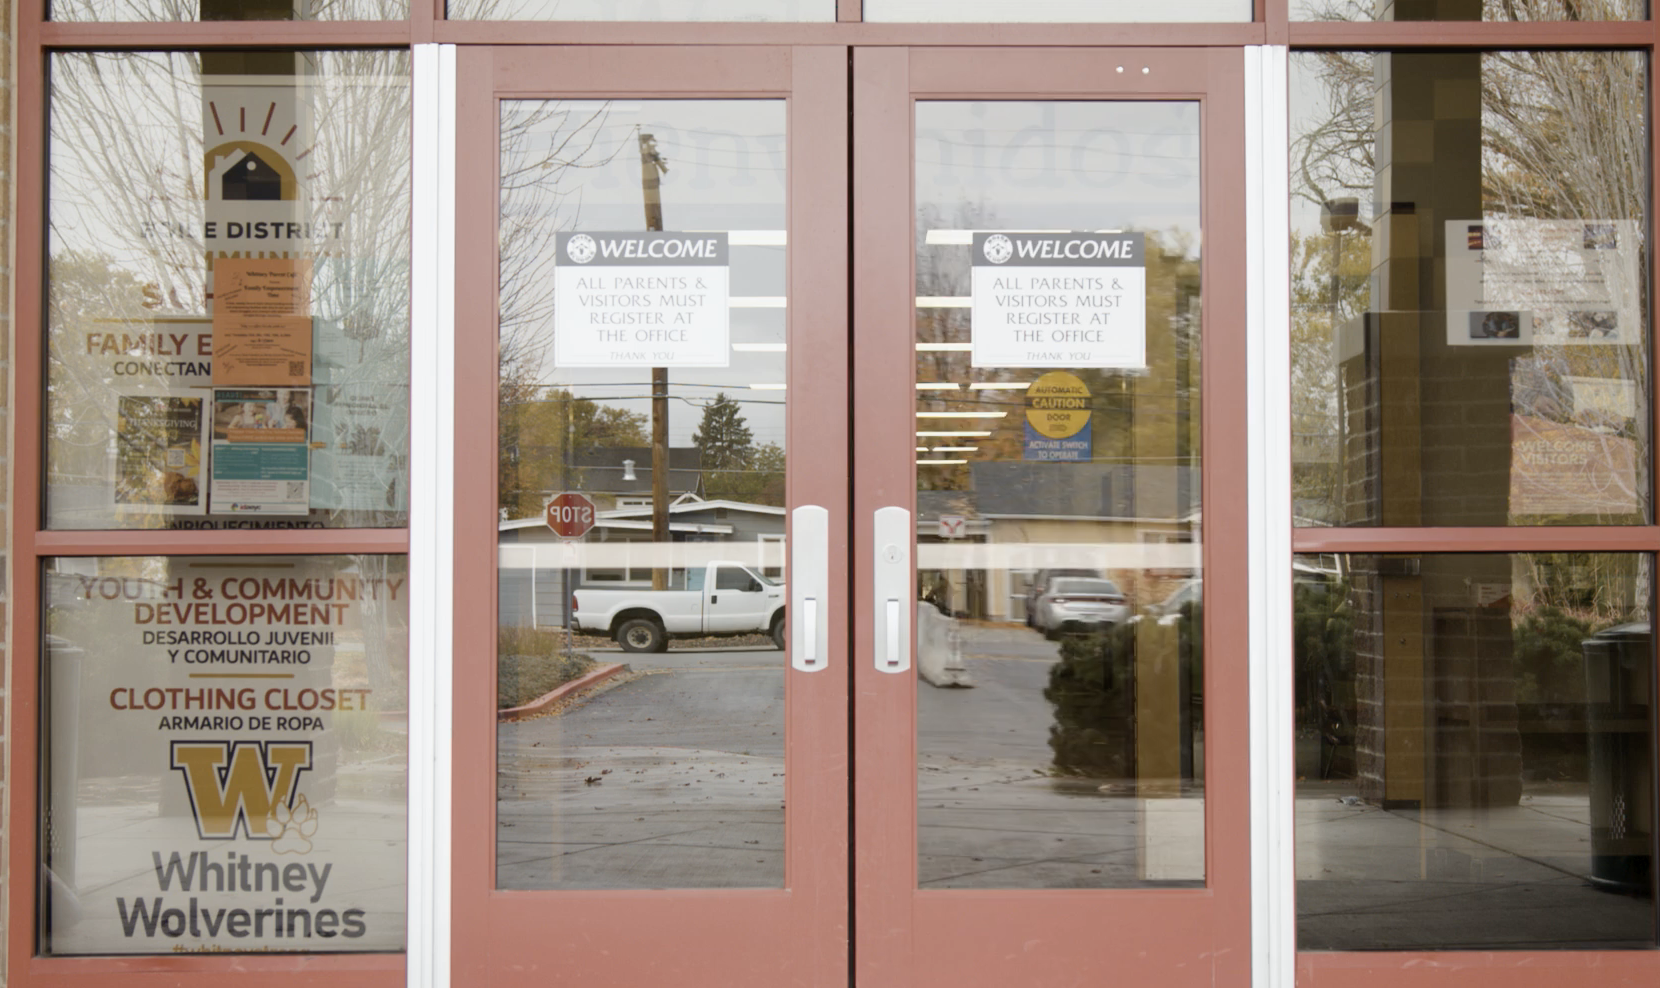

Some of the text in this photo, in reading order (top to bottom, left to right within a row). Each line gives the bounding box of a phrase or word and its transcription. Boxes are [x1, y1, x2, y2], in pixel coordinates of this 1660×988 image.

[600, 239, 717, 258] WELCOME
[1016, 240, 1133, 259] WELCOME
[576, 277, 708, 290] ALL PARENTS &
[993, 277, 1124, 290] ALL PARENTS &
[579, 294, 707, 307] VISITORS MUST
[995, 295, 1122, 308] VISITORS MUST
[590, 312, 694, 325] REGISTER AT
[1006, 312, 1111, 325] REGISTER AT
[597, 329, 688, 342] THE OFFICE
[1013, 330, 1105, 343] THE OFFICE
[86, 333, 189, 356] FAMILY
[610, 351, 675, 361] THANK YOU
[1026, 352, 1092, 361] THANK YOU
[1035, 386, 1083, 394] AUTOMATIC
[1032, 398, 1085, 409] CAUTION
[1046, 413, 1071, 421] DOOR
[1029, 441, 1088, 449] ACTIVATE SWITCH
[1519, 440, 1596, 452] WELCOME
[1037, 451, 1078, 459] TO OPERATE
[1521, 453, 1587, 465] VISITORS
[192, 577, 213, 600] &
[134, 603, 350, 625] DEVELOPMENT
[142, 630, 260, 645] DESARROLLO
[167, 649, 311, 664] Y COMUNITARIO
[109, 687, 373, 711] CLOTHING CLOSET
[158, 715, 324, 731] ARMARIO DE ROPA
[170, 740, 314, 840] W
[152, 851, 333, 903] Whitney
[116, 897, 367, 938] Wolverines
